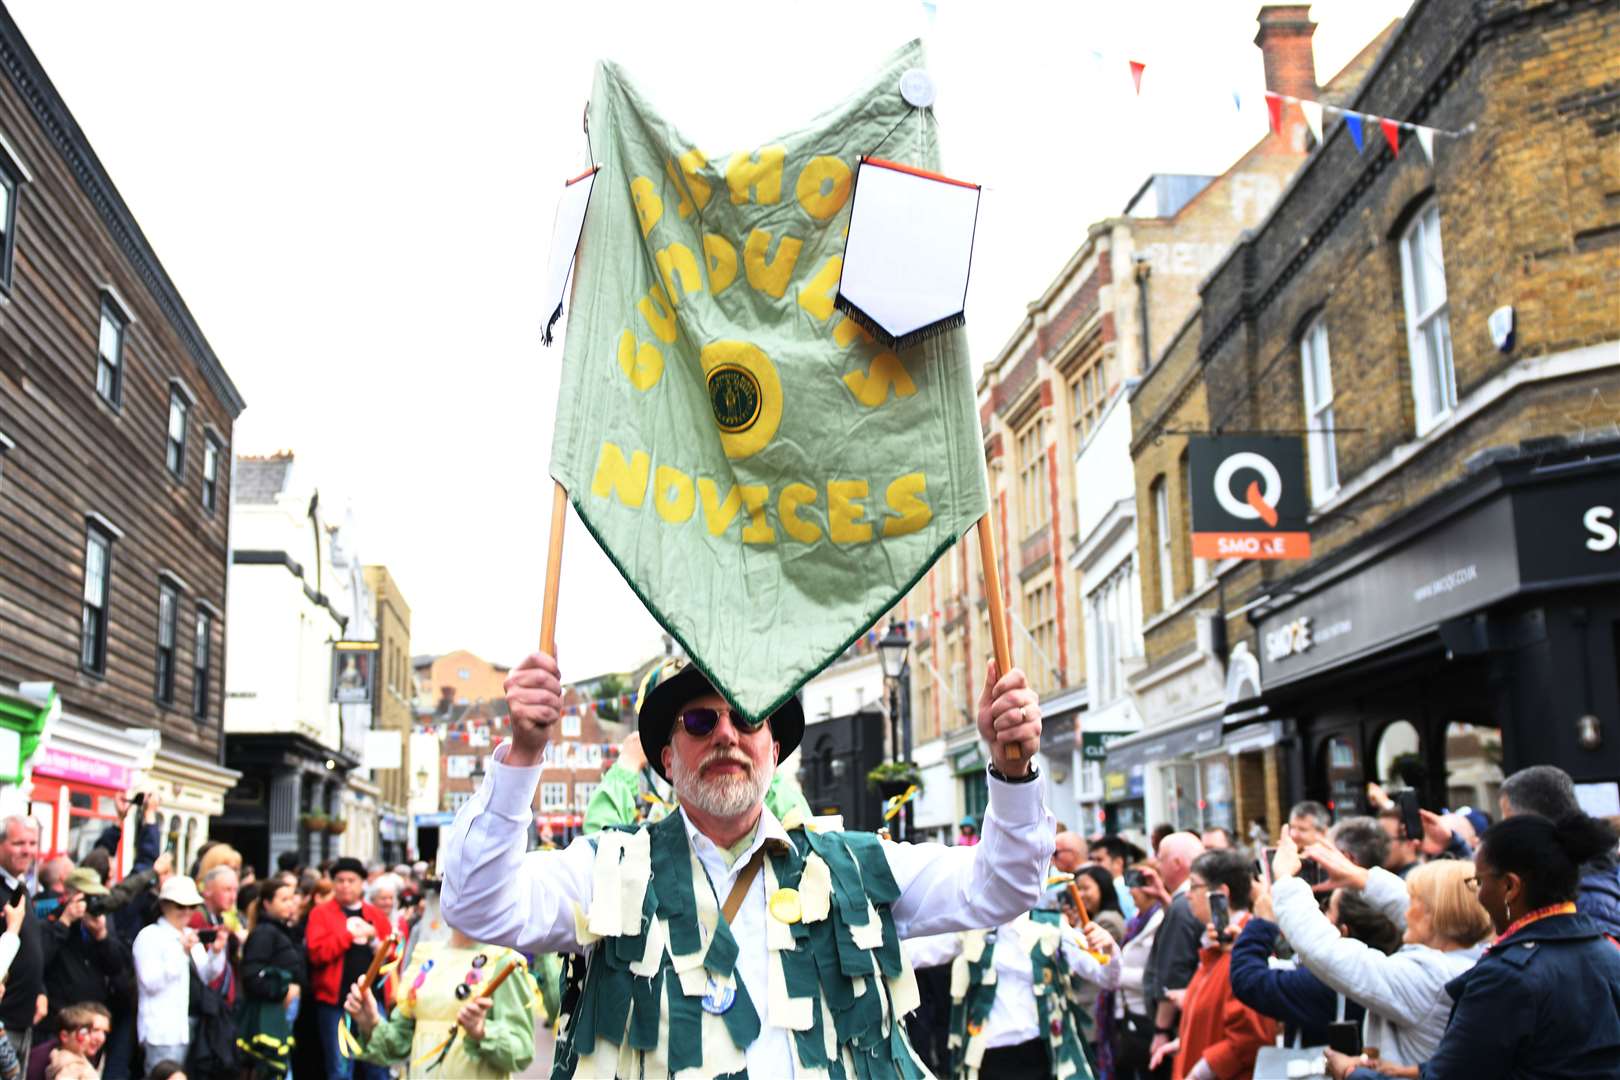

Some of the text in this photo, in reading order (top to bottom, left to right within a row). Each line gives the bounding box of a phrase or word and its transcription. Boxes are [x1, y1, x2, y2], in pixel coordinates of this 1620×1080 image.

[592, 441, 933, 545] NOVICES
[1213, 451, 1281, 528] Q
[1583, 505, 1620, 552] S
